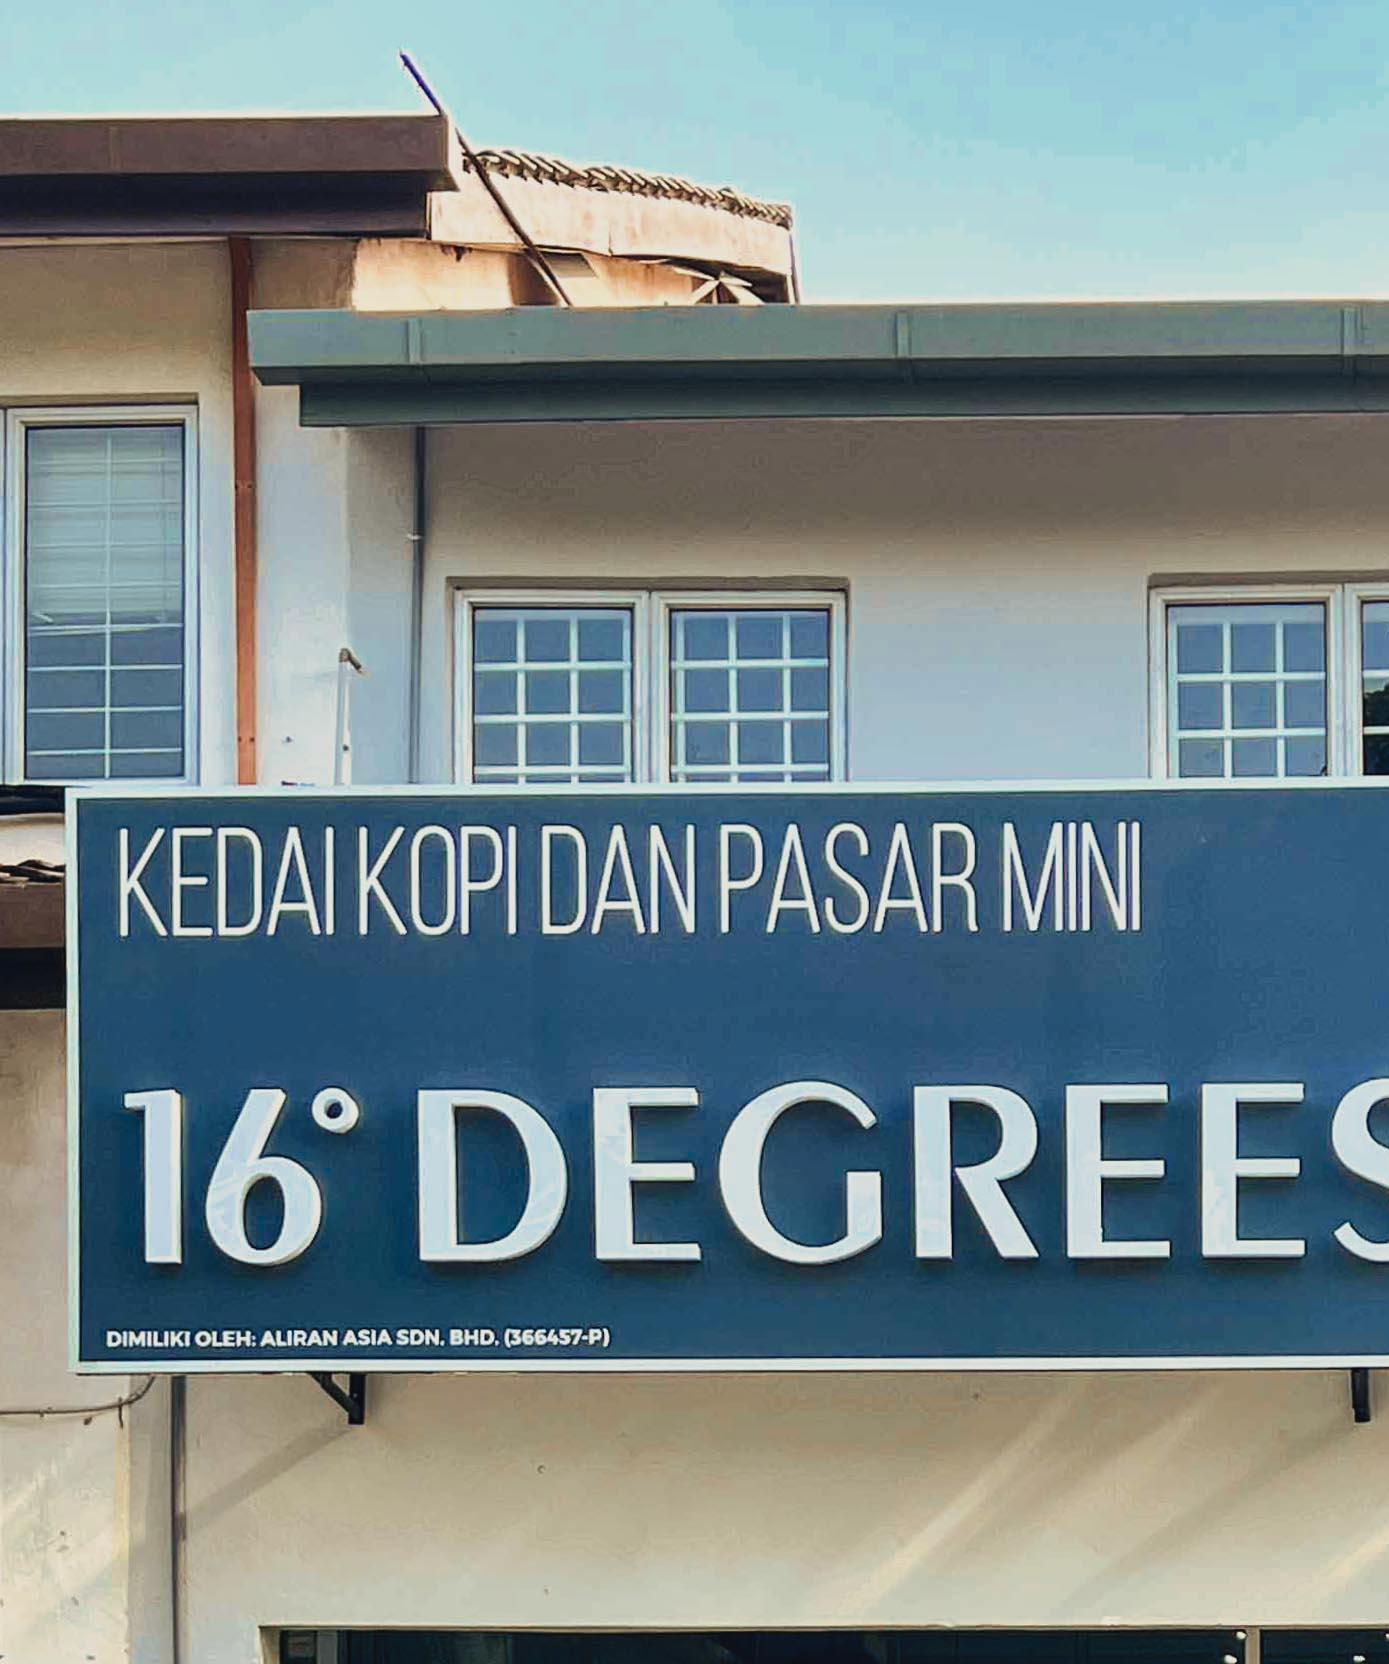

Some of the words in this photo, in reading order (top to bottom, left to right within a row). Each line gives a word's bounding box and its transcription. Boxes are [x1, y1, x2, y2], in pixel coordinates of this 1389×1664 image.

[119, 825, 334, 937] KEDAI
[358, 824, 517, 936] KOPI
[541, 823, 696, 935] DAN
[719, 821, 978, 934] PASAR
[1002, 820, 1142, 932] MINI
[106, 1329, 192, 1349] DIMILIKI
[194, 1329, 257, 1348] OLEH:
[259, 1328, 339, 1348] ALIRAN
[342, 1328, 393, 1347] ASIA
[396, 1328, 445, 1347] SDN.
[449, 1328, 500, 1347] BHD.
[503, 1326, 611, 1348] (366457-P)
